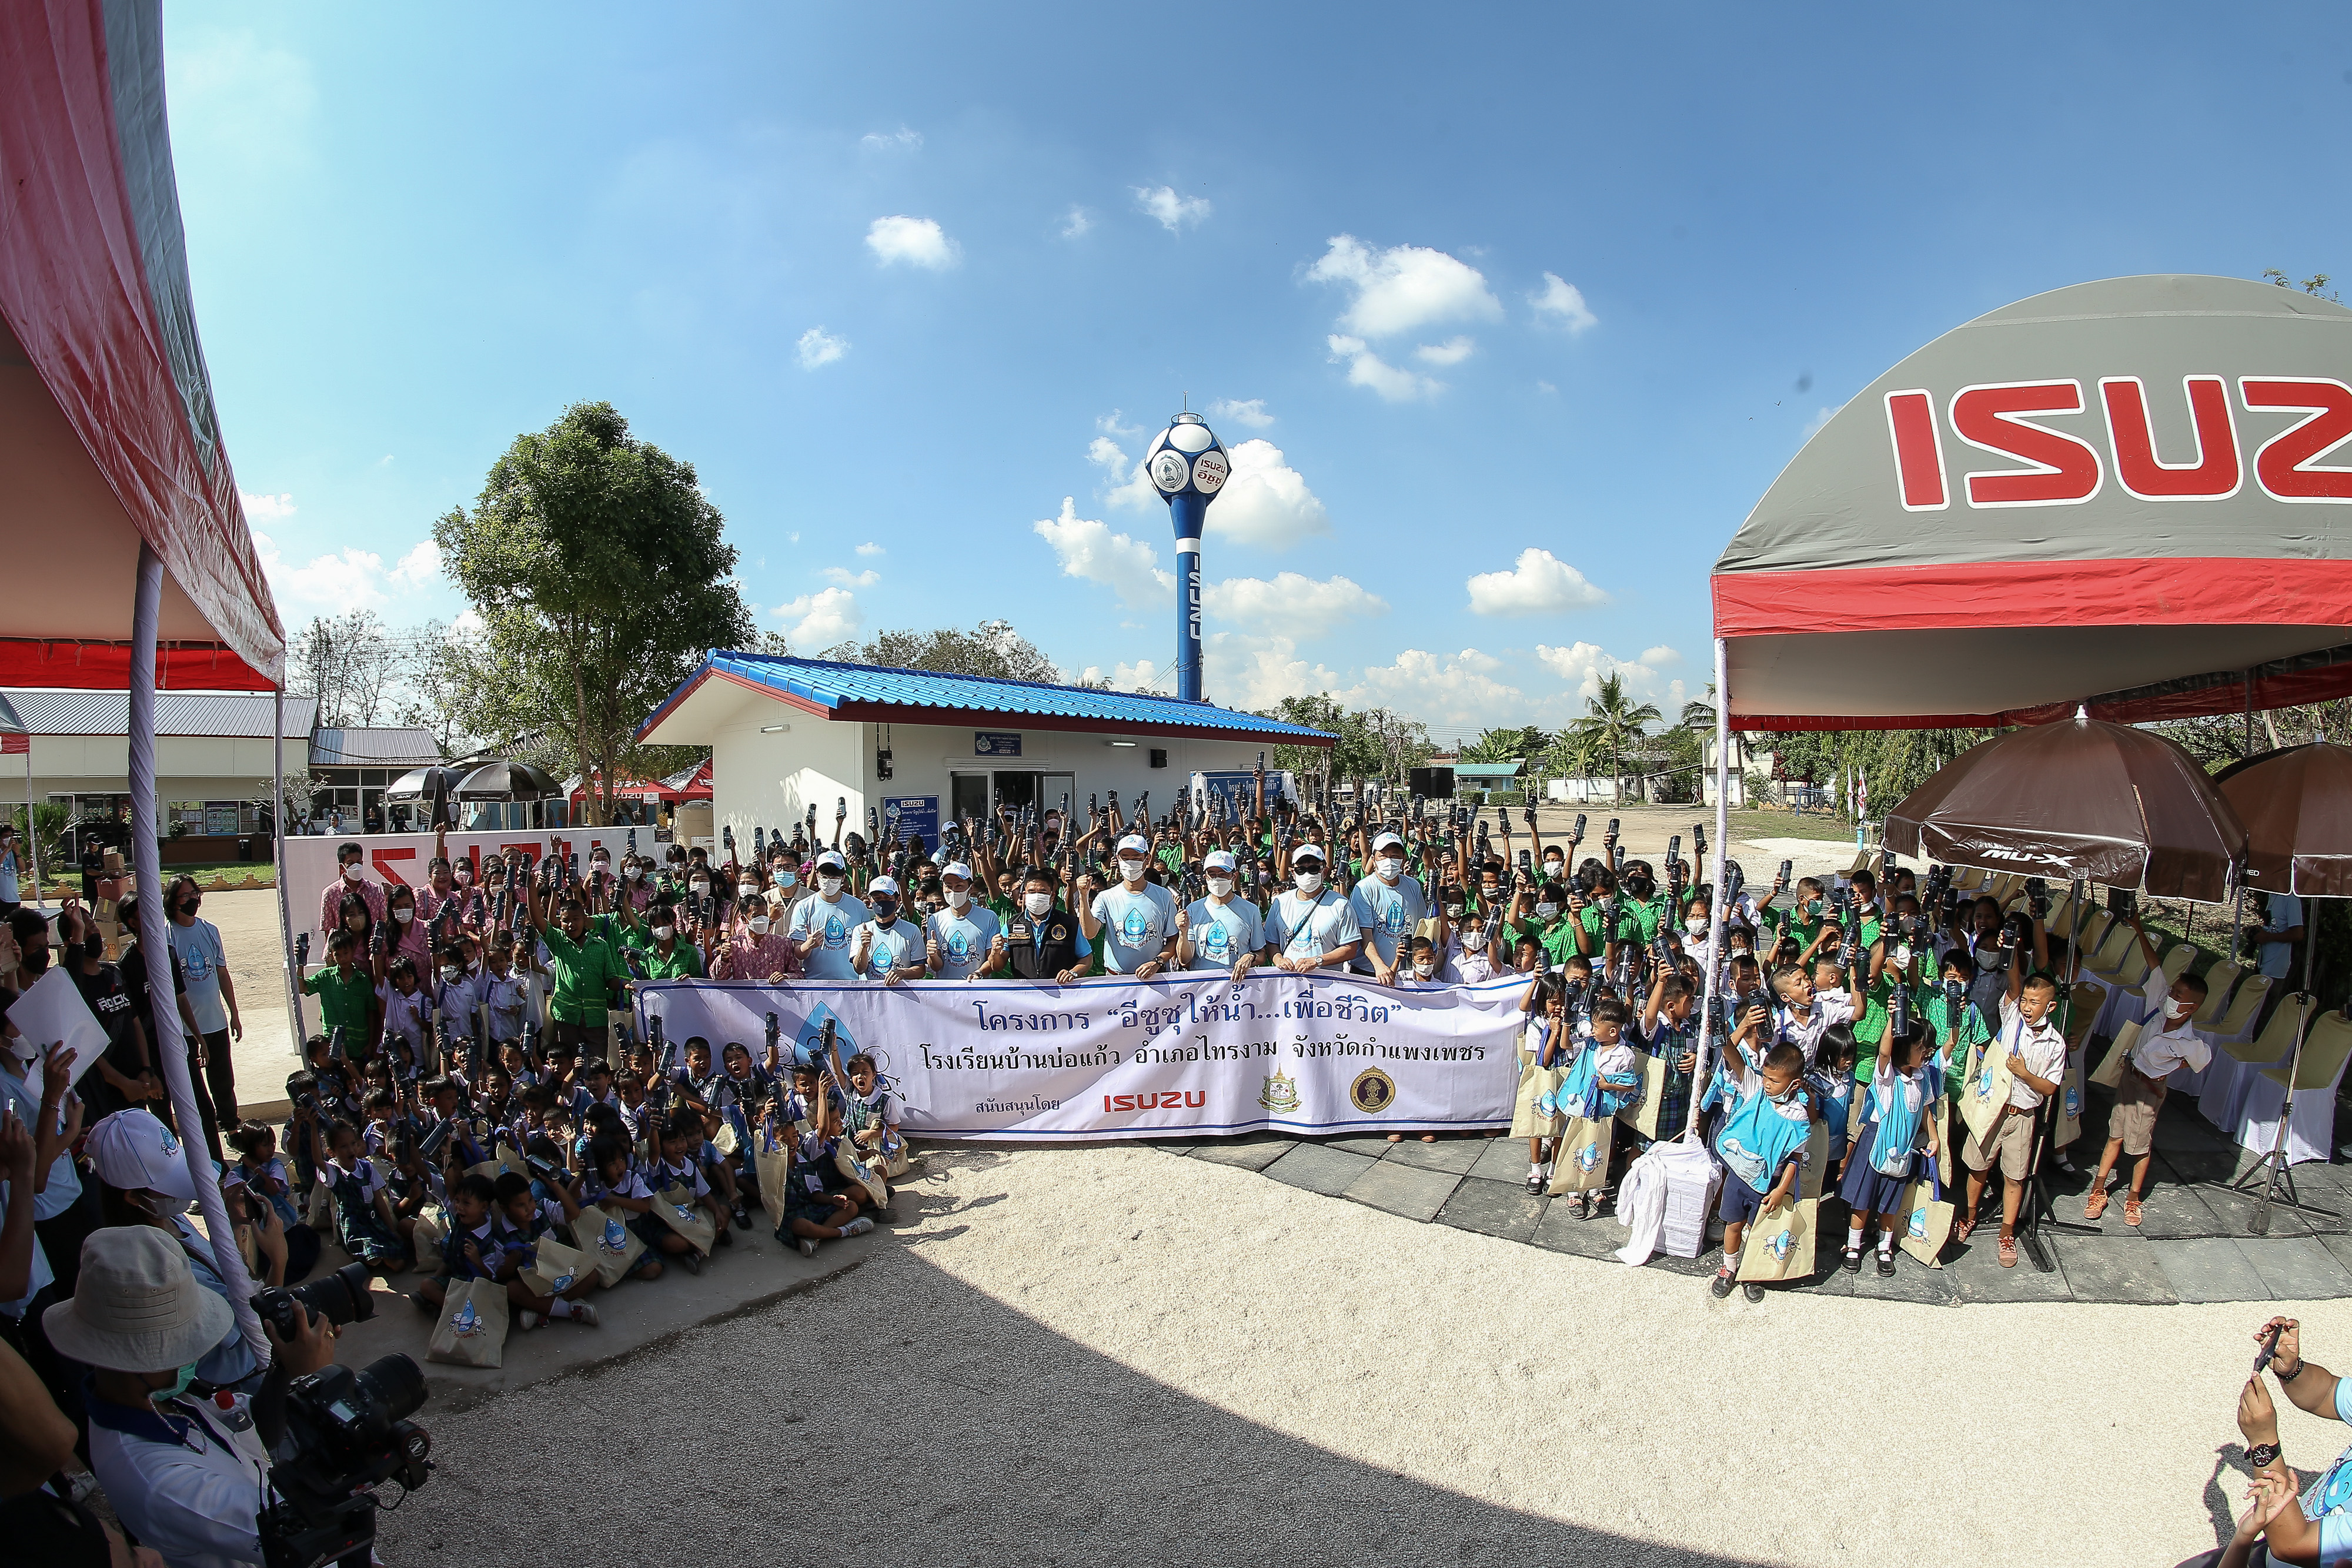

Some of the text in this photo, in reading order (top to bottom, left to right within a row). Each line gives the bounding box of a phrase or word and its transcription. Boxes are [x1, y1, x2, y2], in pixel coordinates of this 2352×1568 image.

[1883, 374, 2352, 512] ISUZ
[1201, 459, 1225, 473] ISUZU
[1198, 470, 1222, 486] อีซูซุ
[98, 993, 129, 1011] ROCK
[972, 1000, 1090, 1031] โครงการ
[919, 1034, 1485, 1069] โรงเรียนบ้านบ่อแก้ว อำเภอไทรงาม จังหวัดกำแพงเพชร
[975, 1094, 1060, 1116] สนับสนุนโดย
[1104, 1090, 1207, 1113] ISUZU
